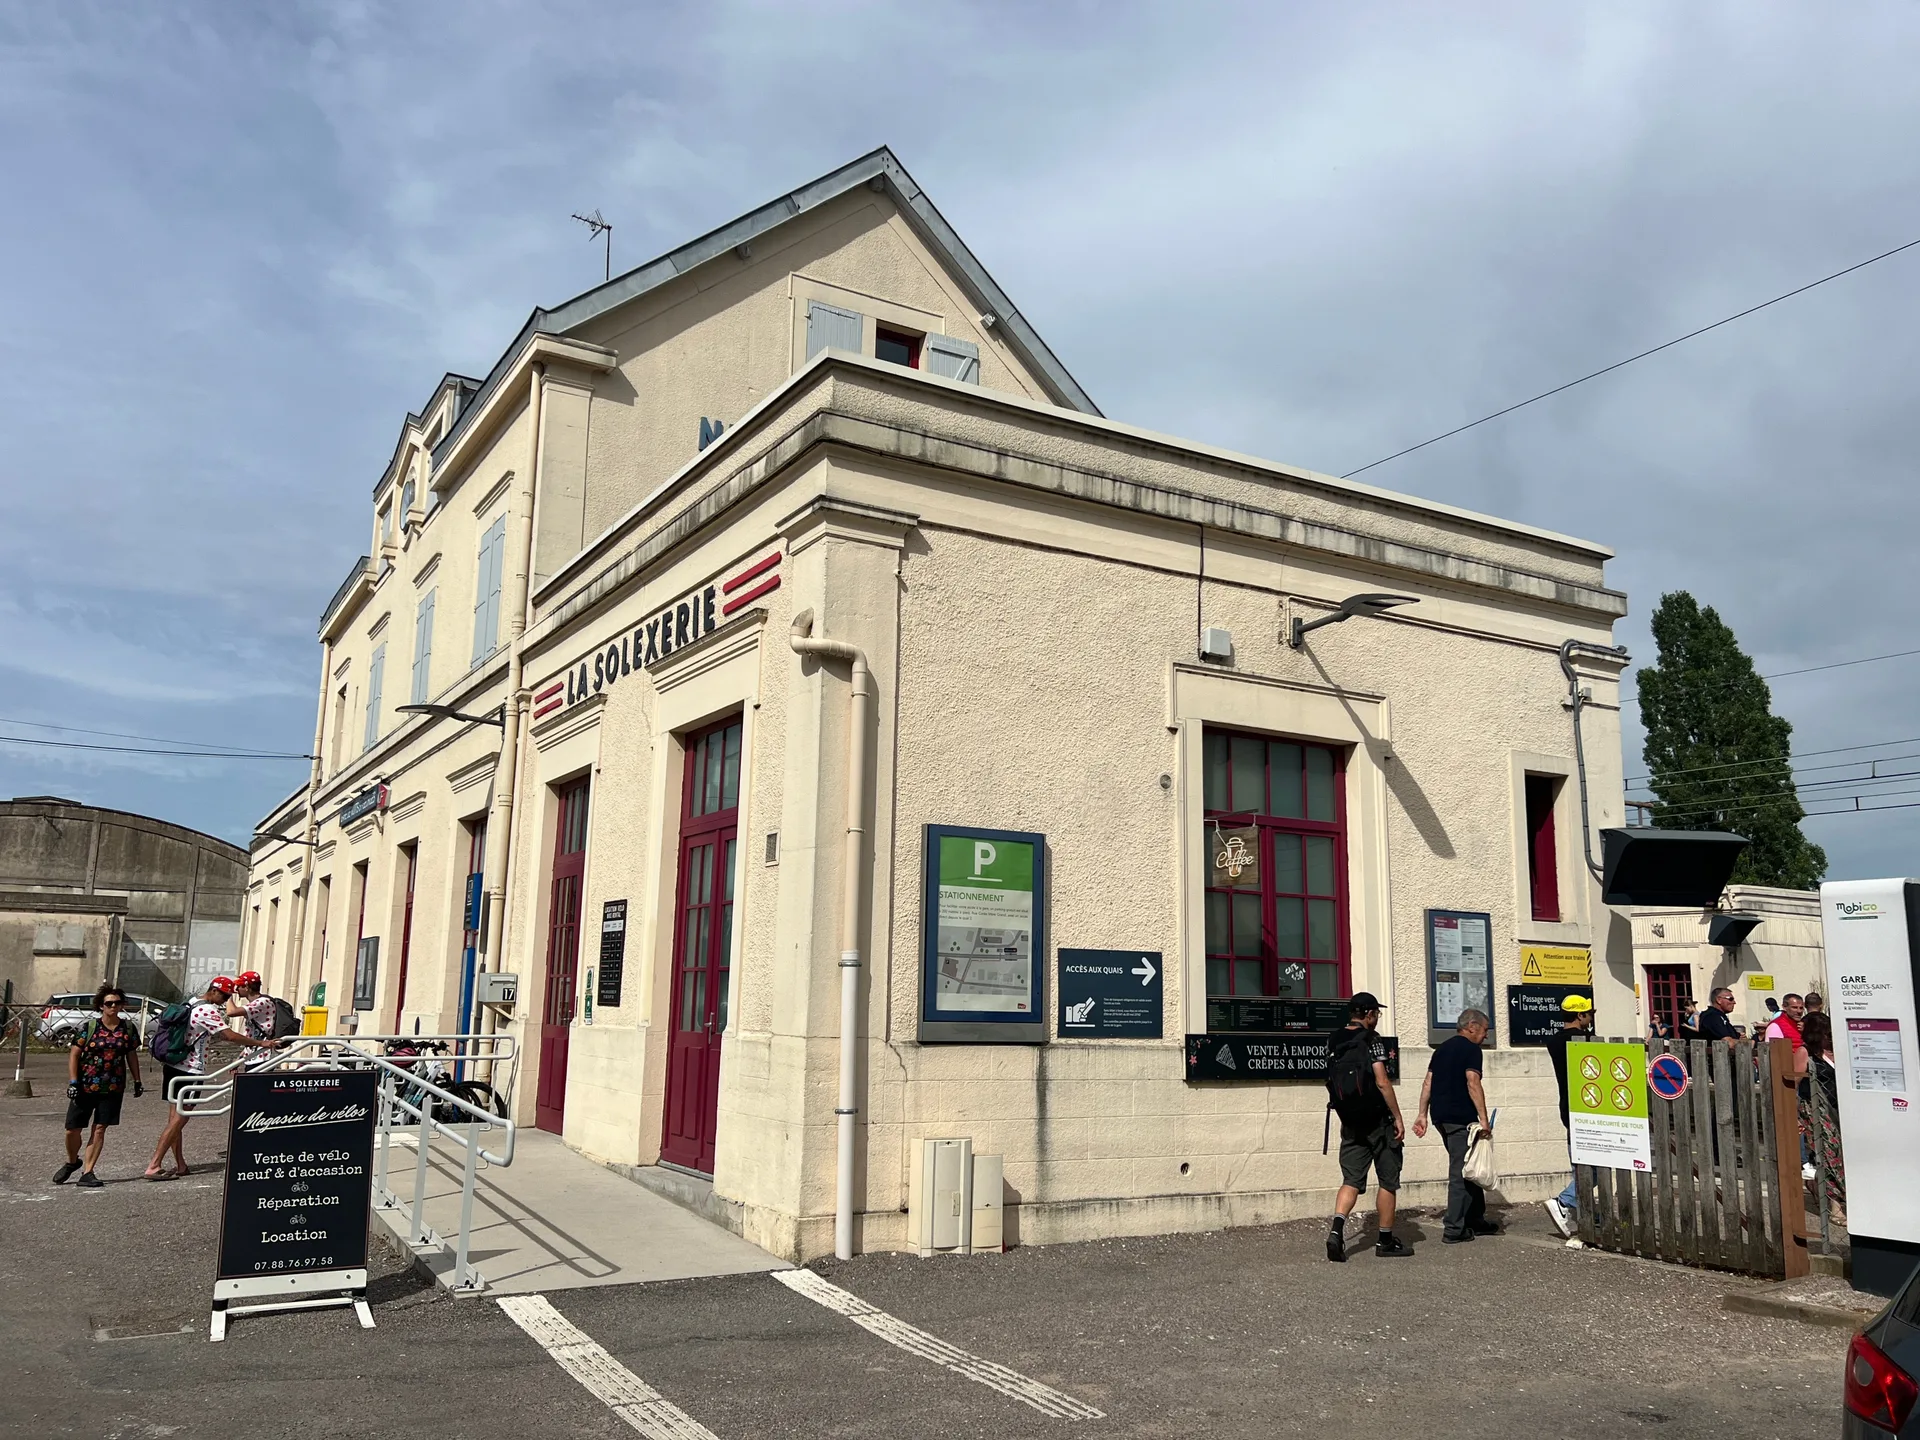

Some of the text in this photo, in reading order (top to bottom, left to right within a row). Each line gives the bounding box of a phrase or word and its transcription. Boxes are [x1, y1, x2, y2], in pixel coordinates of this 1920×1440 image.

[698, 416, 734, 452] N
[567, 585, 715, 705] LA SOLEXERIE
[974, 841, 996, 875] P
[939, 890, 1005, 902] STATIONNEMENT
[1065, 964, 1088, 973] ACCÈS
[1103, 966, 1124, 975] QUAIS
[1840, 975, 1867, 983] GARE
[504, 988, 515, 1000] 17
[1522, 994, 1544, 1005] Passage
[1549, 1003, 1560, 1012] Blés
[1541, 1028, 1553, 1036] Paul
[1246, 1045, 1280, 1056] VENTE
[1281, 1043, 1289, 1056] À
[1247, 1056, 1286, 1070] CRÊPES
[1287, 1060, 1295, 1069] &
[273, 1079, 340, 1088] LA SOLEXERIE
[238, 1103, 369, 1133] Magasin de vélos
[1597, 1120, 1620, 1128] SÉCURITÉ
[253, 1150, 350, 1165] Vente de vélo
[237, 1164, 363, 1181] neuf & d'accasion
[256, 1195, 340, 1211] Réparation
[261, 1230, 328, 1243] Location
[254, 1256, 334, 1271] 07.88.76.97.58
